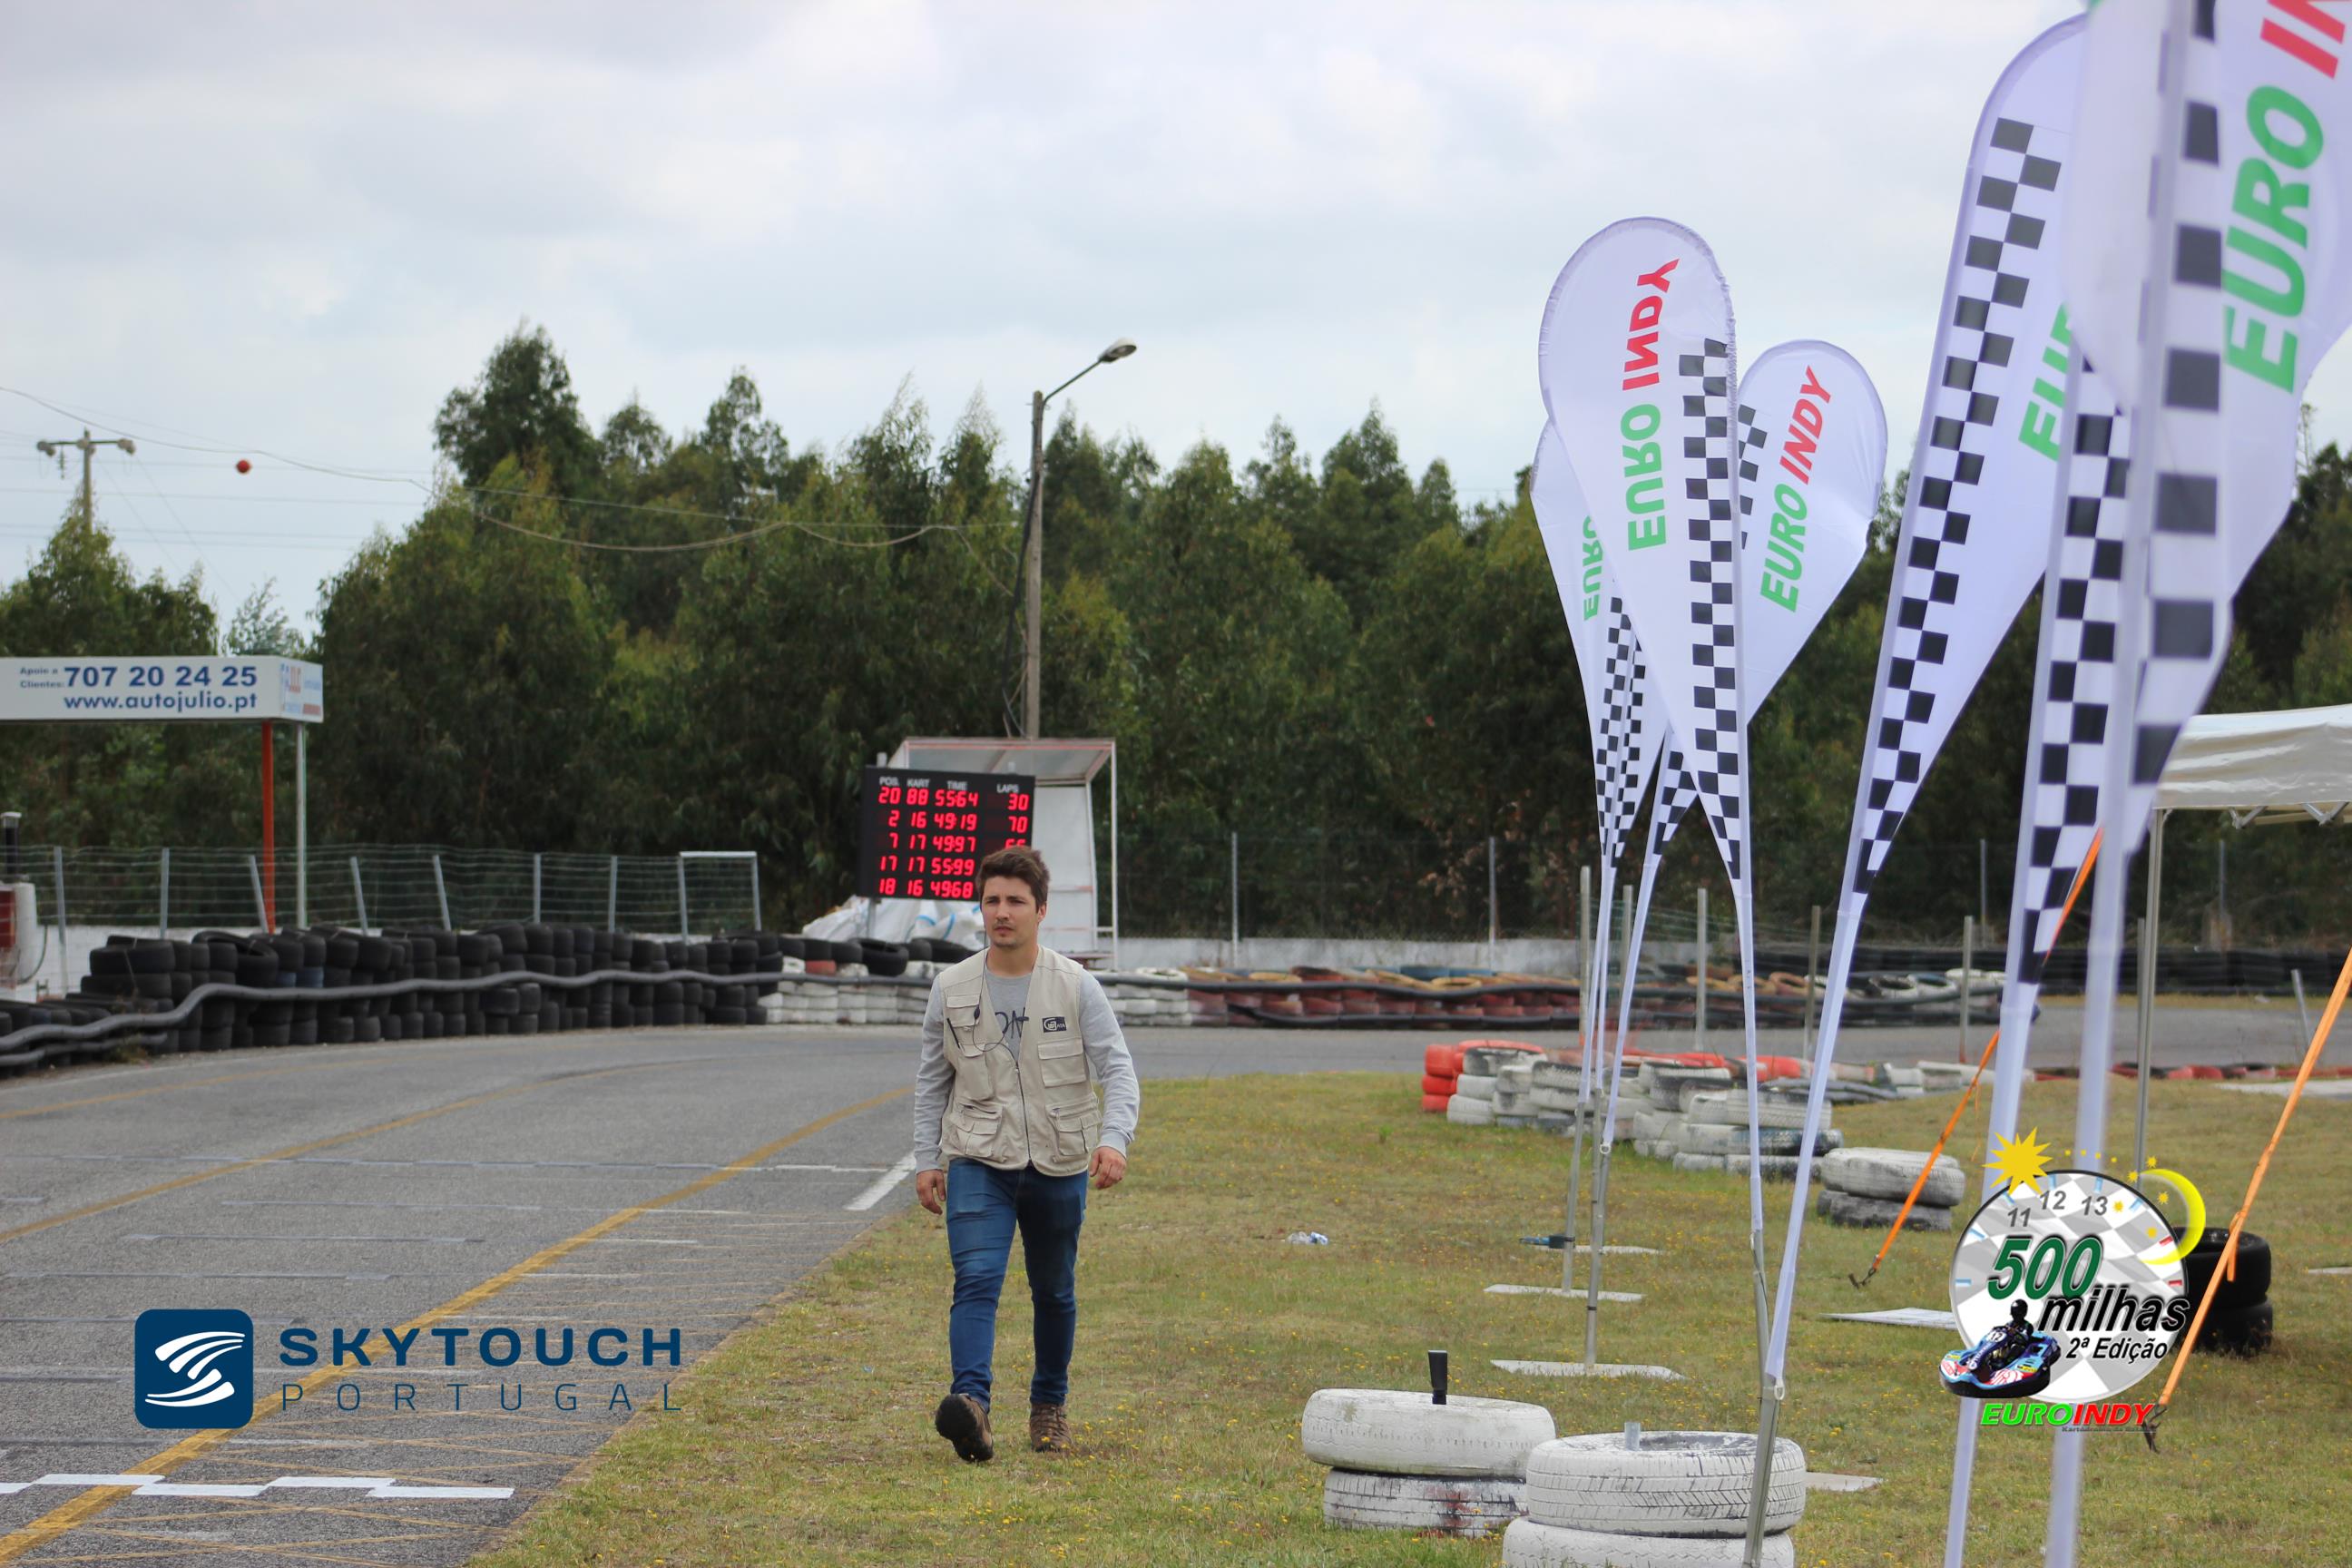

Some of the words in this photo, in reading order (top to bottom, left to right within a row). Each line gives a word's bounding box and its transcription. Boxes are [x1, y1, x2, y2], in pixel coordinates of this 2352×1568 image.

[2221, 85, 2325, 396] EURO
[1779, 365, 1831, 485] INDY
[1760, 483, 1808, 613] EURO
[64, 666, 118, 688] 707
[129, 666, 165, 688] 20
[175, 666, 211, 688] 24
[221, 666, 258, 688] 25
[64, 691, 258, 713] www.autojulio.pt
[906, 779, 930, 789] KART
[946, 780, 967, 791] TIME
[996, 784, 1019, 794] LAPS
[877, 786, 902, 805] 20
[906, 788, 929, 806] 88
[1007, 793, 1030, 811] 30
[887, 809, 900, 828] 2
[910, 810, 927, 828] 16
[1008, 816, 1028, 834] 70
[889, 832, 899, 848] 7
[909, 833, 926, 850] 17
[880, 855, 898, 871] 17
[908, 857, 926, 873] 17
[878, 877, 897, 896] 18
[906, 878, 924, 897] 16
